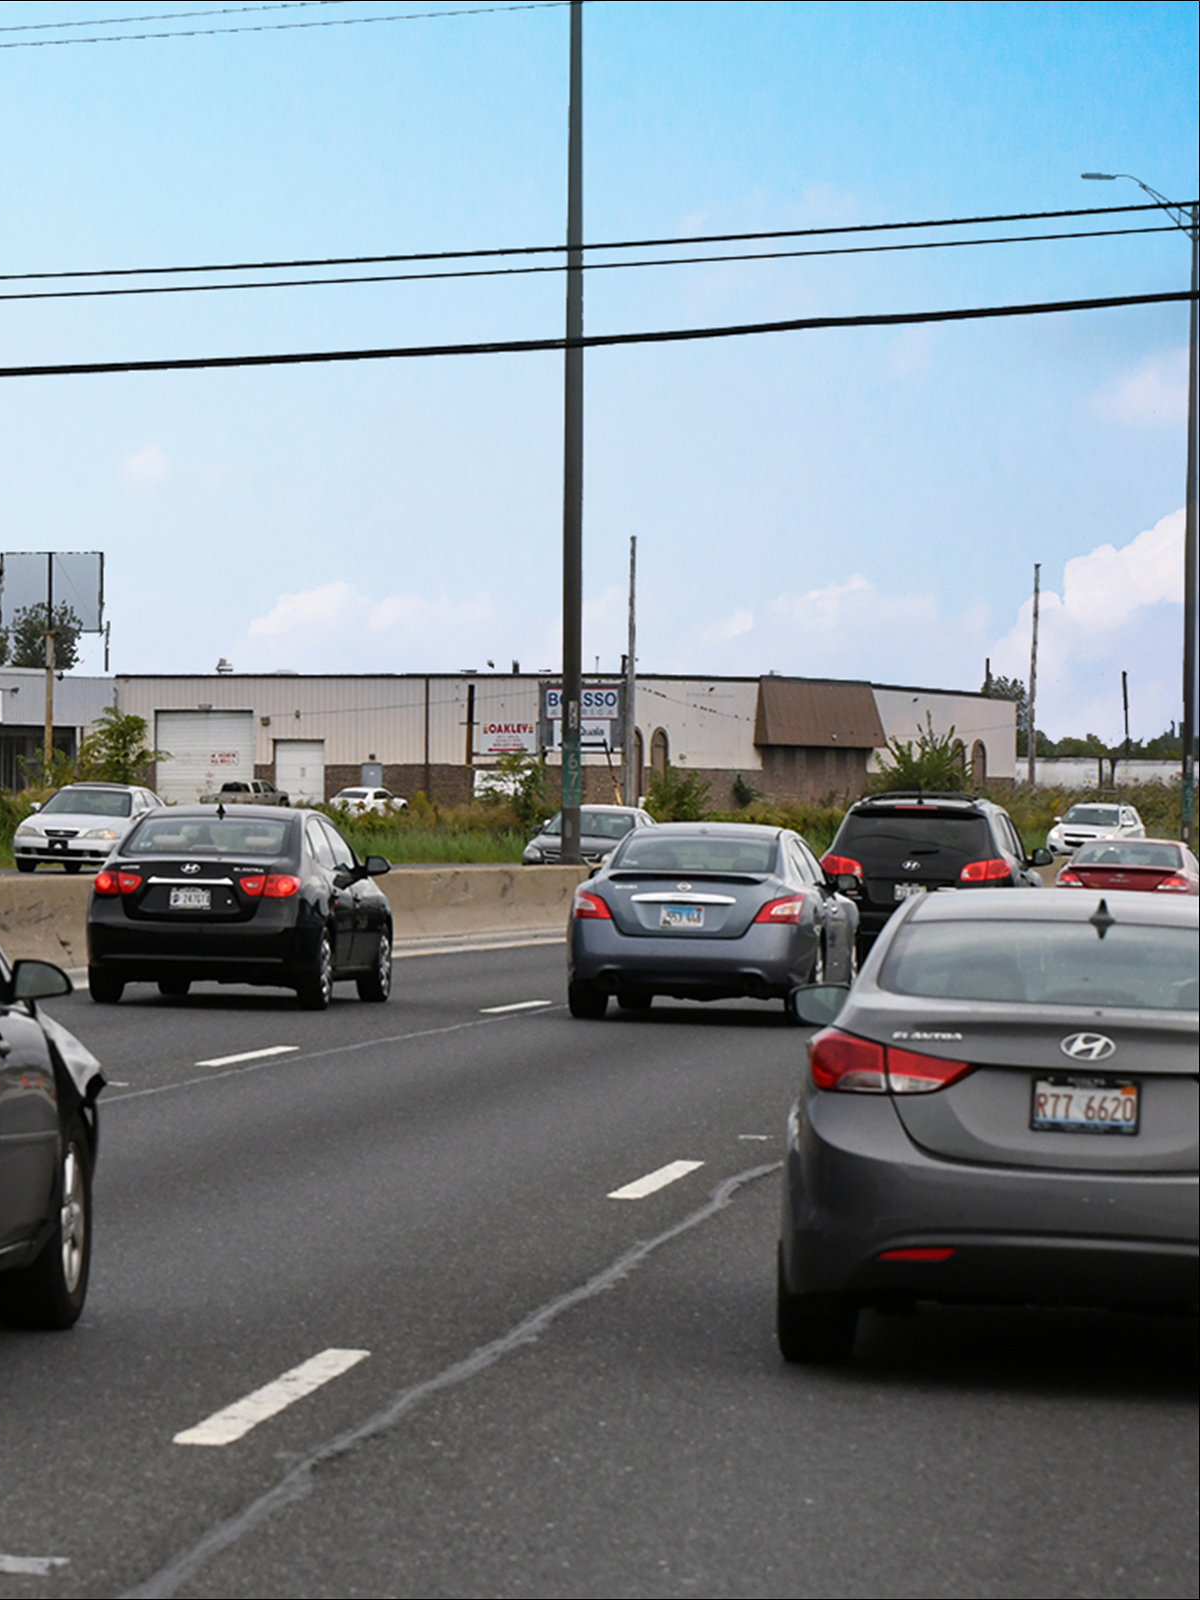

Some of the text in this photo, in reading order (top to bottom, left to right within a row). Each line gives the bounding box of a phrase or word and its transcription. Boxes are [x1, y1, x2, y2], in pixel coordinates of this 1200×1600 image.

[548, 692, 617, 707] BSSO
[488, 724, 528, 733] OAKLEY
[1036, 1093, 1136, 1123] R77 6620
